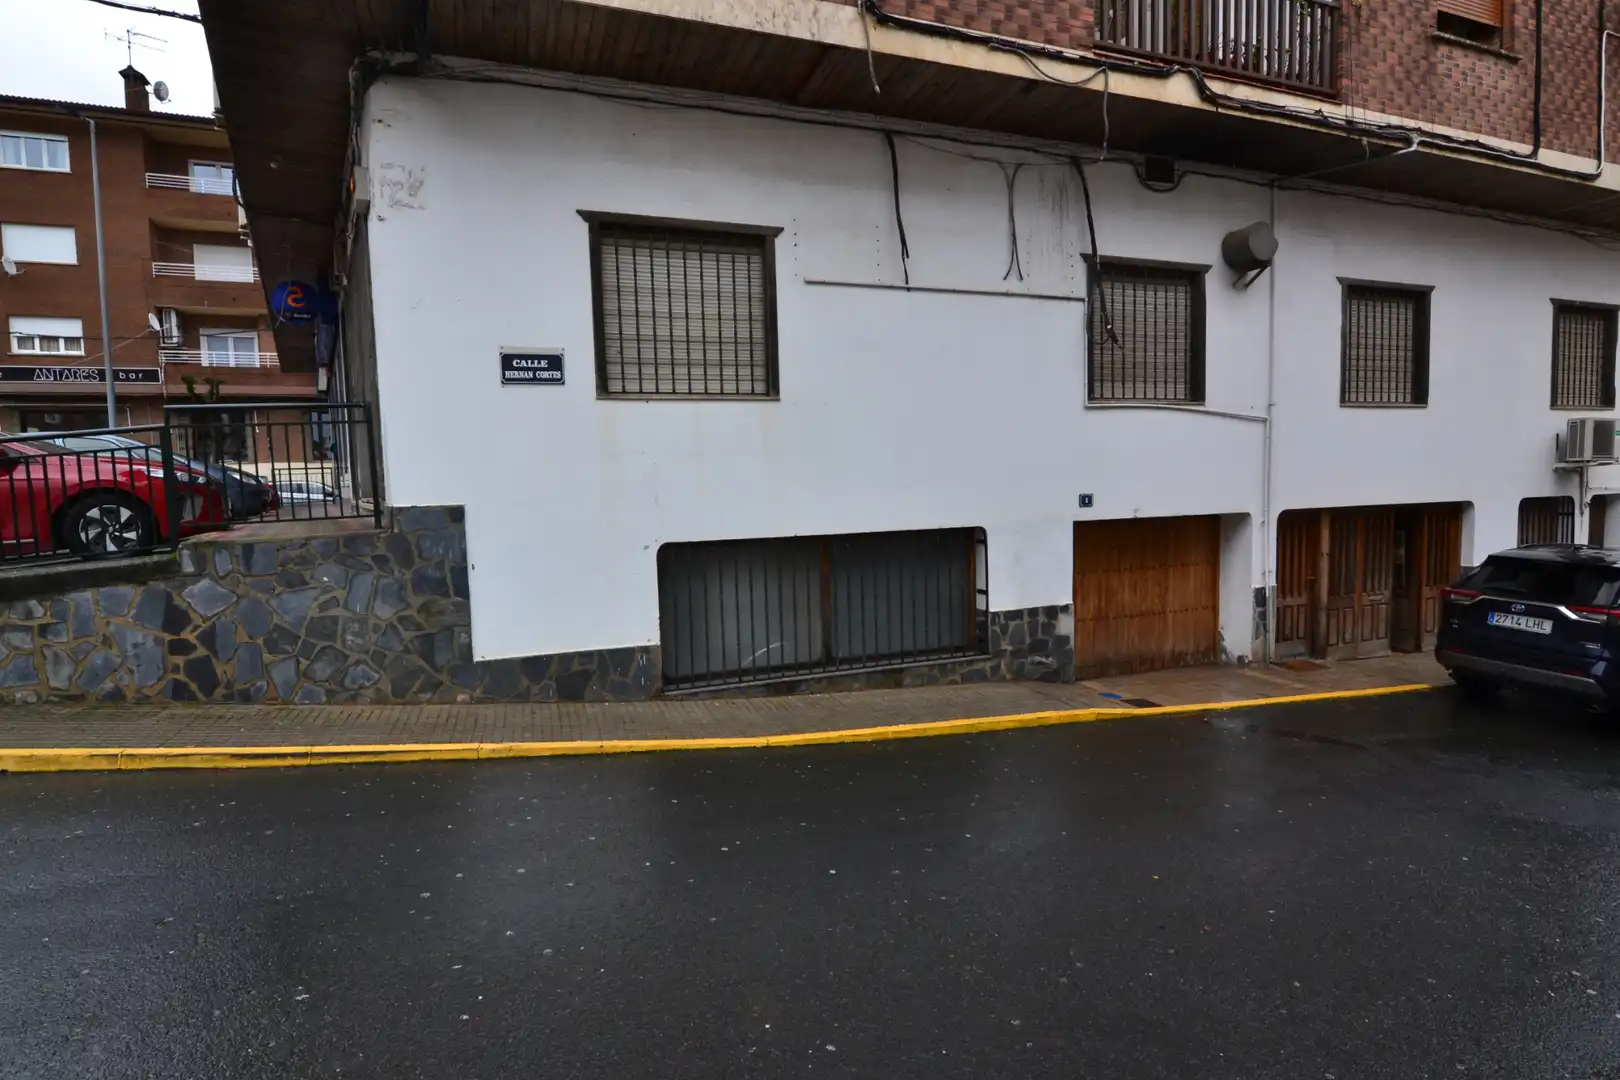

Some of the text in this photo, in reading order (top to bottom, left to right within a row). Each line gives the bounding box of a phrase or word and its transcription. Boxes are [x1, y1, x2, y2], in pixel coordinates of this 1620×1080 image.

[512, 359, 548, 368] CALLE
[33, 368, 144, 382] ANTARES bar
[504, 370, 562, 379] HERNAN CORTES
[1495, 613, 1547, 631] 2714 LHL
